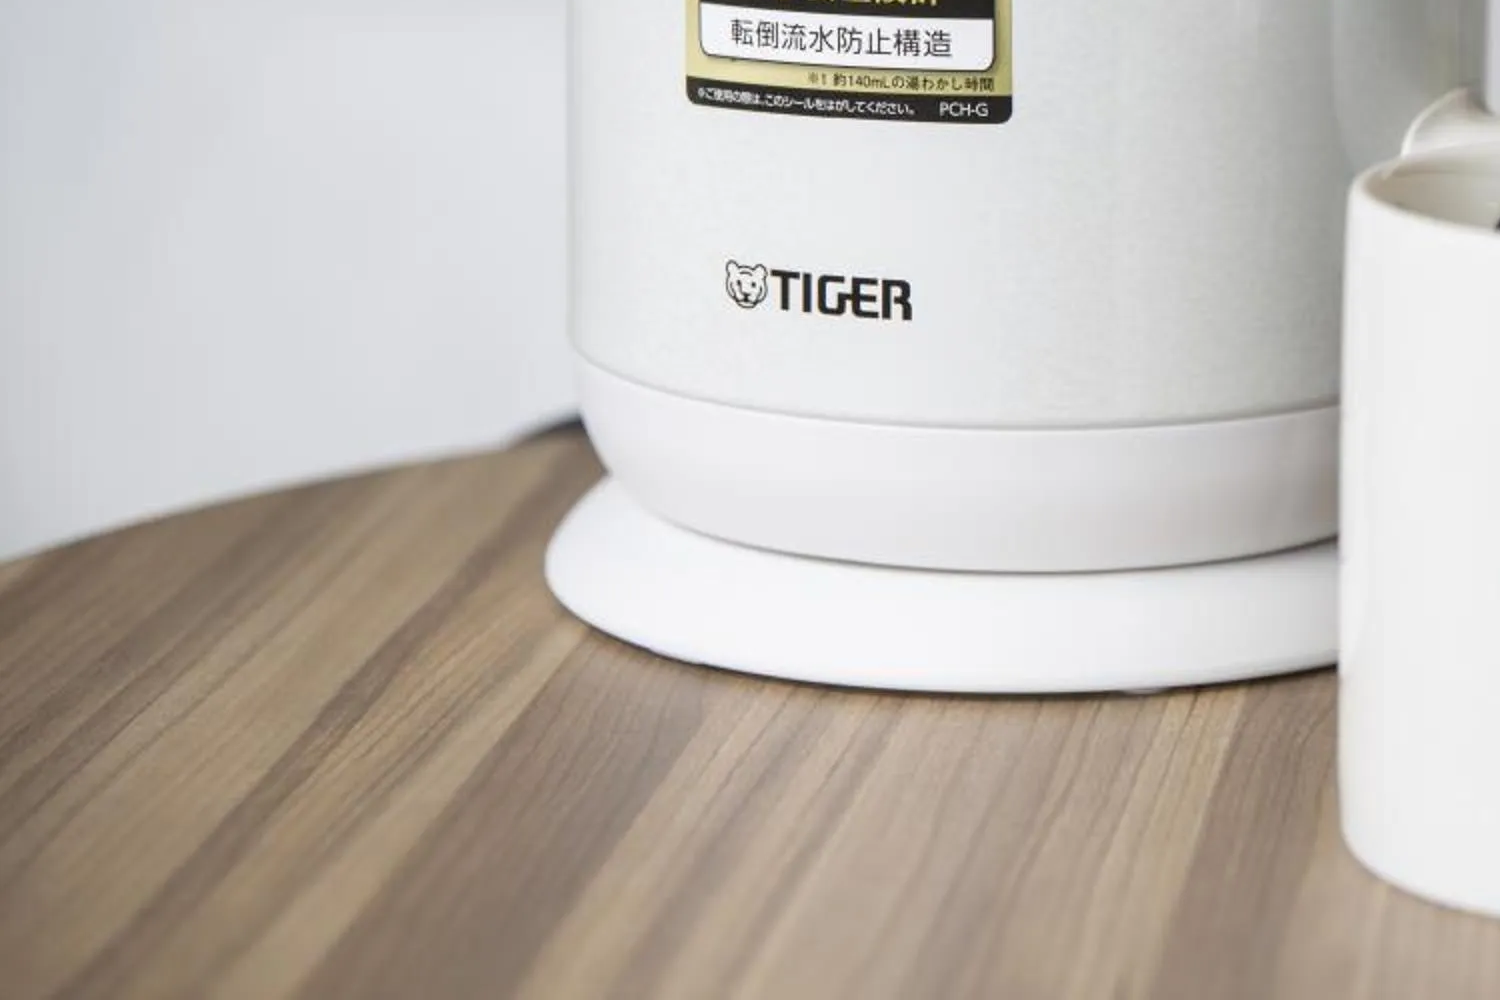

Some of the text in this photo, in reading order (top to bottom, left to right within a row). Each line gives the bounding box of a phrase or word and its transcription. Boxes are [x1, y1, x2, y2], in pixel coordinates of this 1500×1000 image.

[731, 18, 953, 59] 転倒流水防止構造
[939, 101, 990, 118] PCH-G
[769, 268, 913, 321] TIGER
